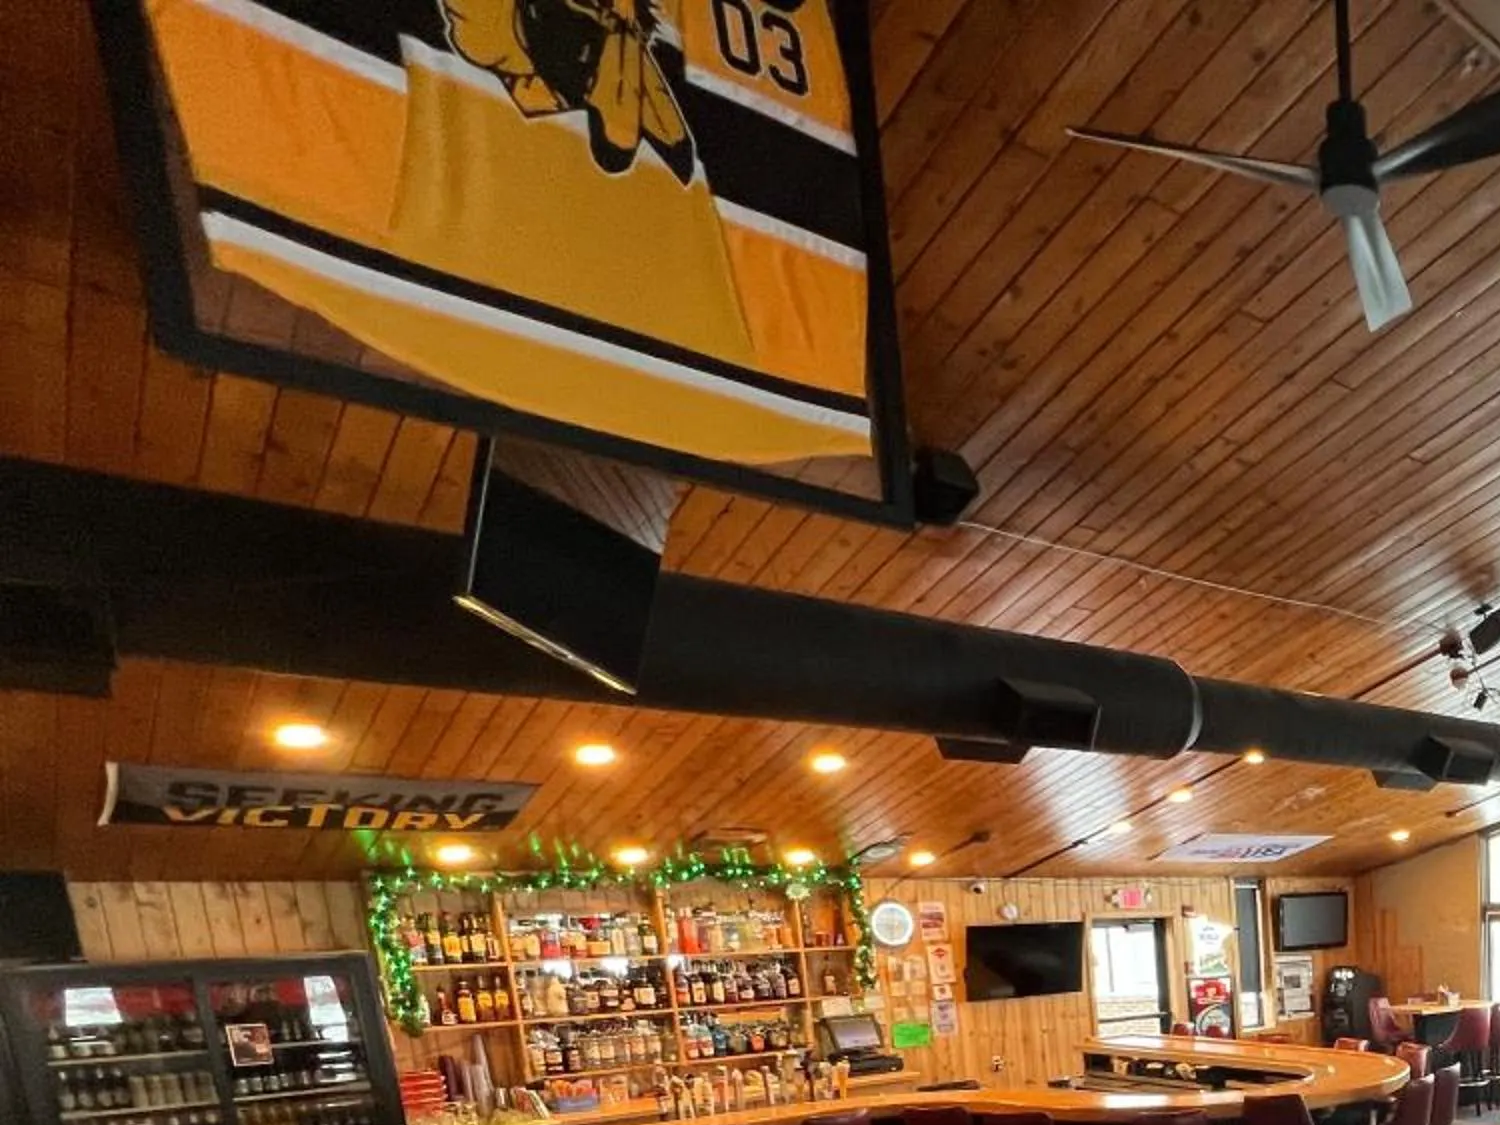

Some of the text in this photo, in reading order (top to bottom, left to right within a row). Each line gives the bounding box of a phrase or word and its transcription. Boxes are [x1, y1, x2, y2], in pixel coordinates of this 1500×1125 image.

[711, 0, 810, 96] 03
[165, 781, 504, 813] SEEKING
[161, 803, 485, 830] VICTORY
